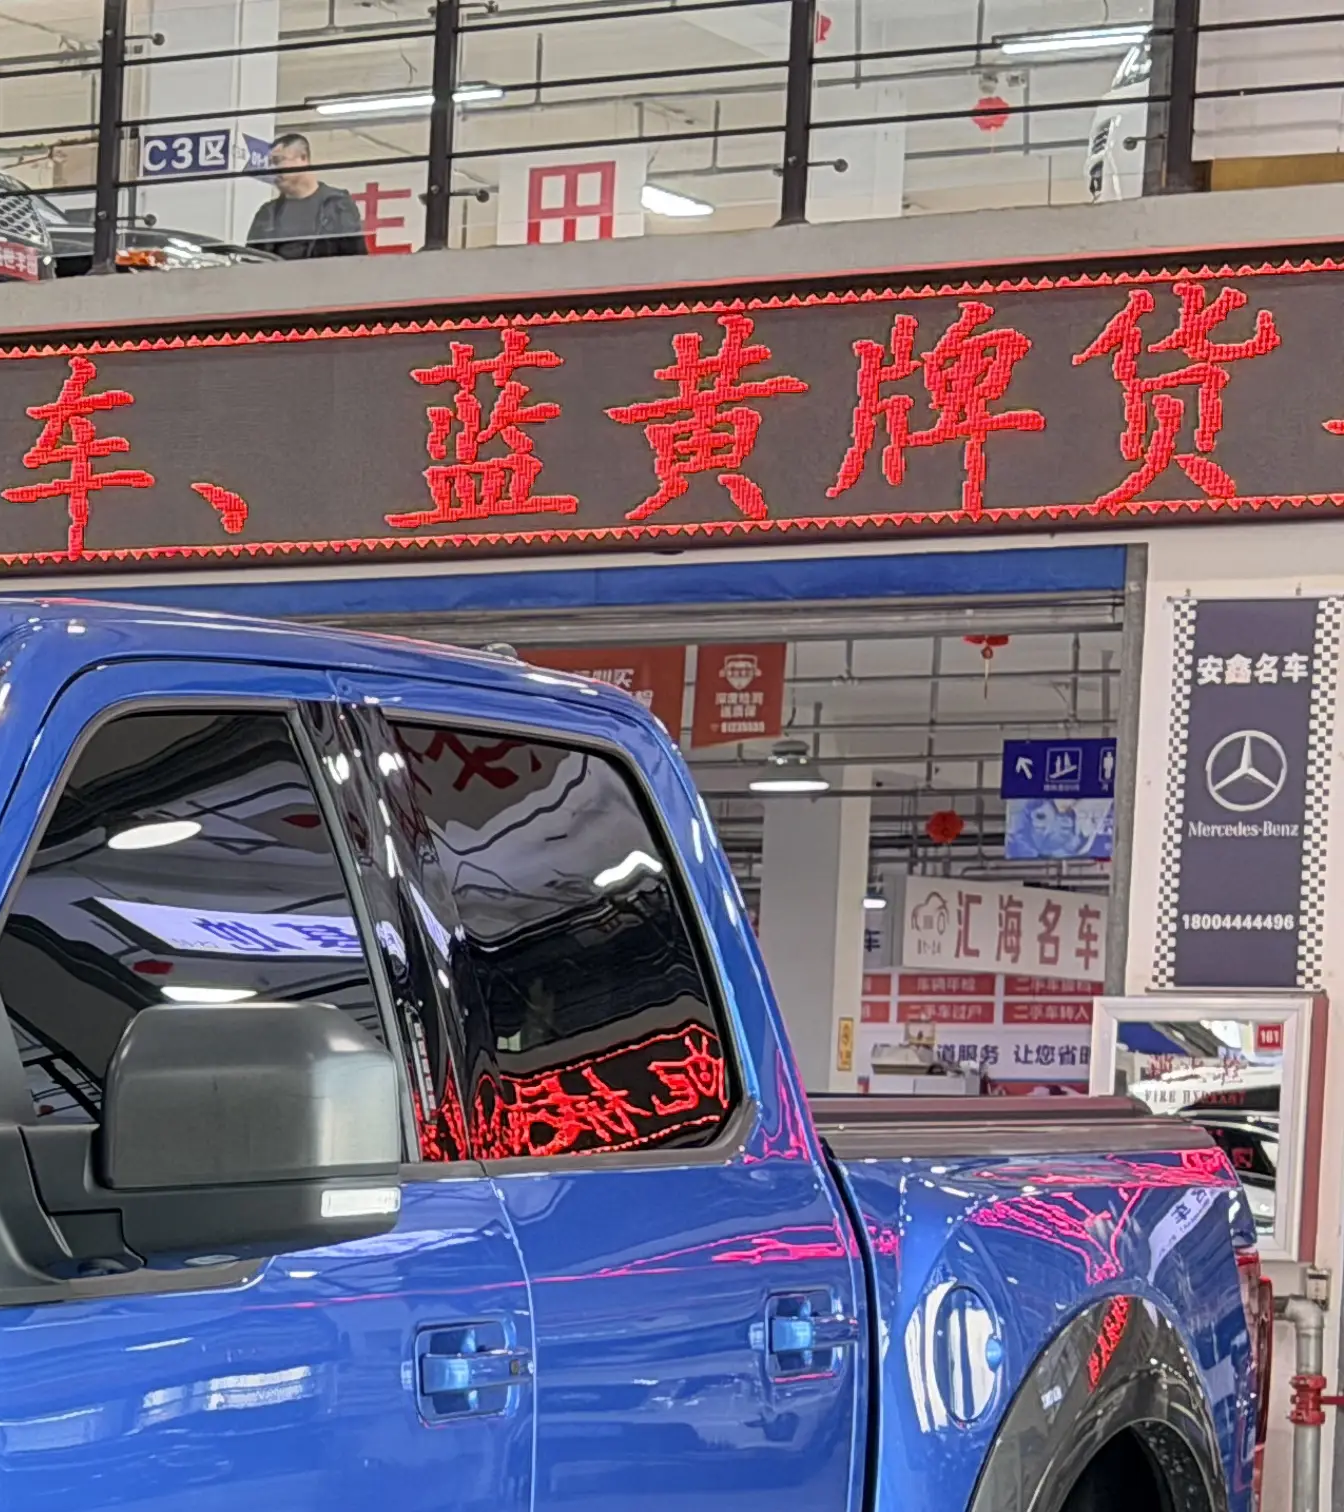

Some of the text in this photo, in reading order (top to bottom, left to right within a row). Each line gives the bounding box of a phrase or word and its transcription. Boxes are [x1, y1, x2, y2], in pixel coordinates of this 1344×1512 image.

[144, 135, 226, 171] C3区
[385, 283, 1344, 528] 蓝黄牌货
[1197, 653, 1309, 685] 安鑫名车
[1188, 820, 1300, 838] Mercedes-Benz
[955, 890, 1101, 971] 汇海名车
